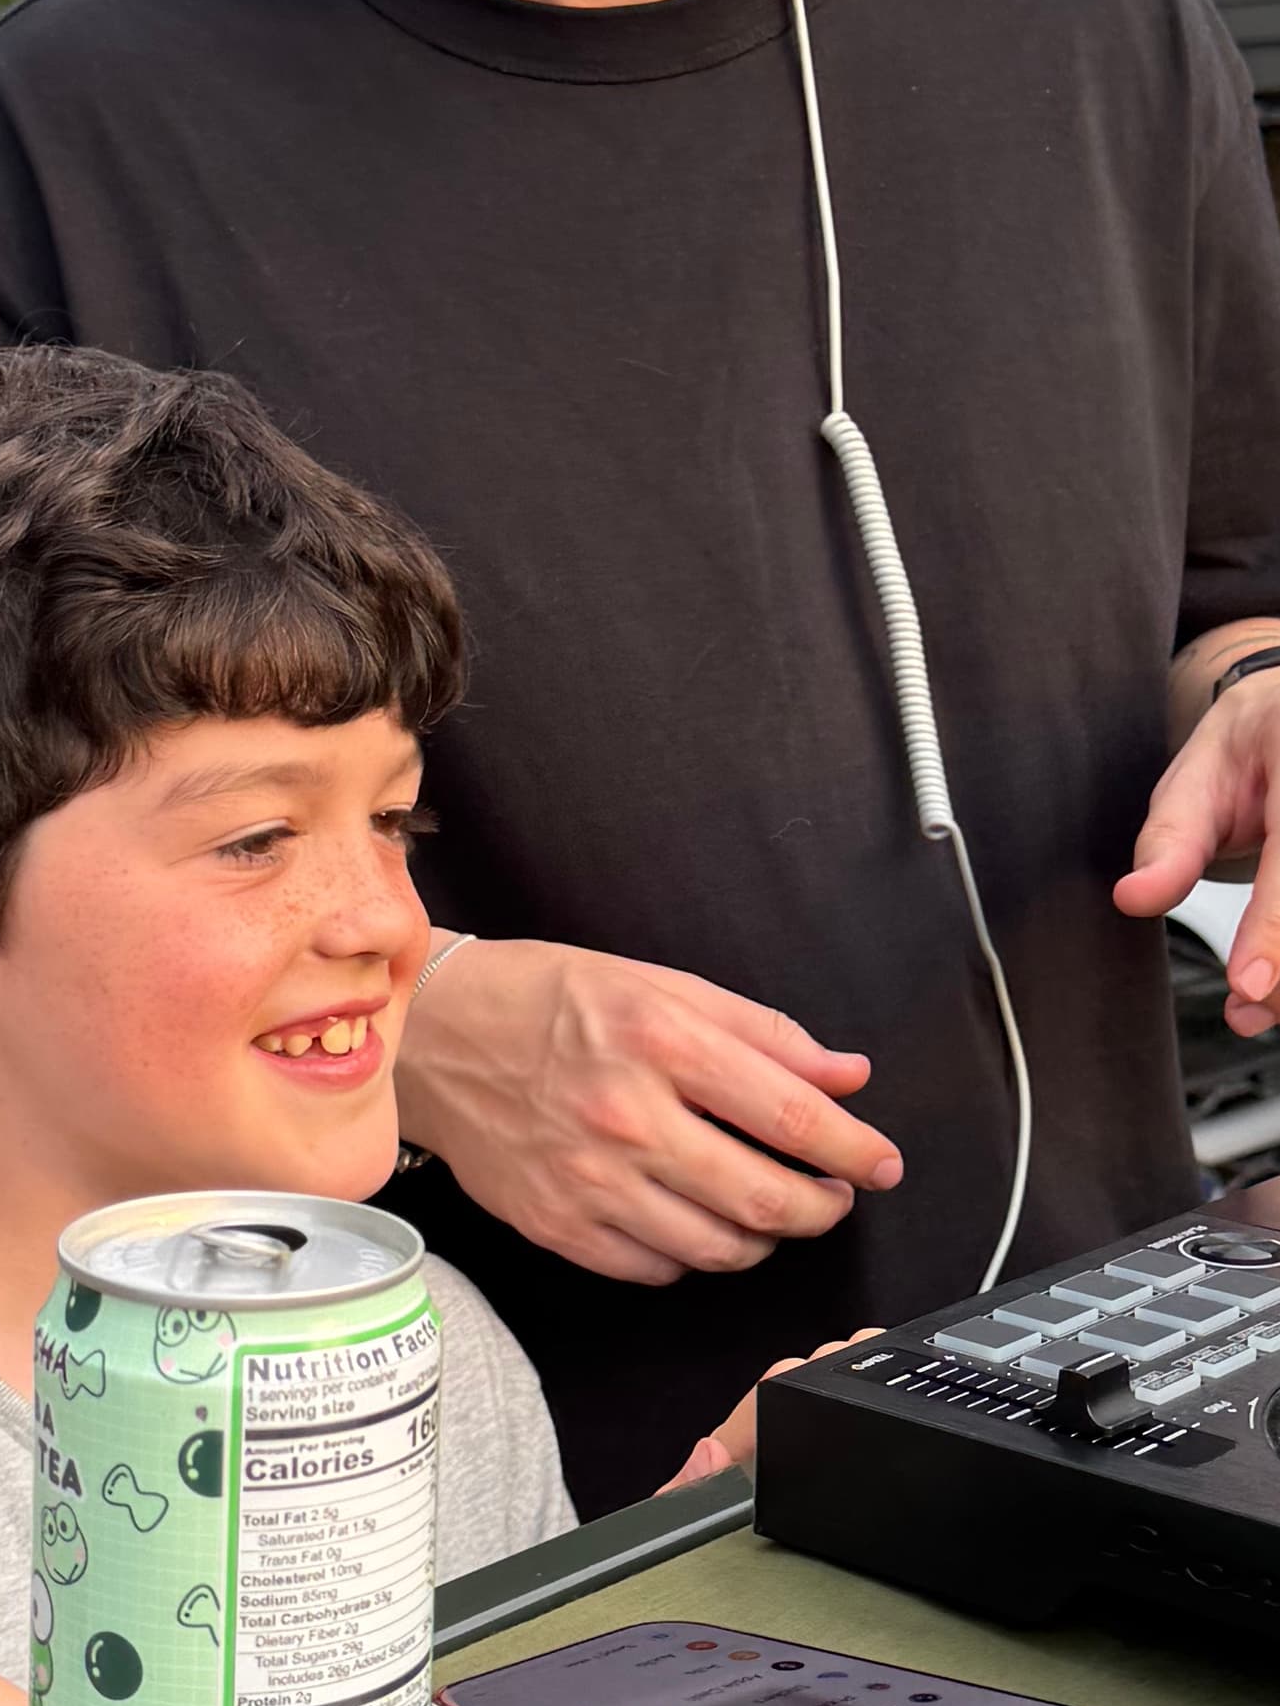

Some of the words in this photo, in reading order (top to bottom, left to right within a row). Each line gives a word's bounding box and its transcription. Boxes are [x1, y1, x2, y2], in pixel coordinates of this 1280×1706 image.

[248, 1349, 388, 1382] Nutrition
[391, 1319, 437, 1357] Facts
[260, 1383, 318, 1403] servings
[322, 1381, 342, 1399] per
[348, 1368, 398, 1391] container
[245, 1404, 317, 1422] Serving
[322, 1399, 355, 1416] size
[245, 1442, 294, 1456] Amount
[299, 1440, 319, 1453] Per
[323, 1435, 365, 1450] Serving
[245, 1448, 375, 1482] Calories
[243, 1513, 279, 1527] Total
[284, 1511, 307, 1525] Fat
[257, 1529, 325, 1547] Saturated
[329, 1524, 349, 1538] Fat
[258, 1552, 297, 1567] Trans
[301, 1549, 323, 1564] Fat
[326, 1547, 343, 1562] 0g
[240, 1569, 325, 1588] Cholesterol
[330, 1562, 363, 1579] 10mg
[240, 1592, 297, 1609] Sodium
[240, 1614, 276, 1629] Total
[280, 1597, 371, 1626] Carbohydrate
[255, 1632, 305, 1649] Dietary
[309, 1626, 341, 1642] Fiber
[255, 1652, 288, 1668] Total
[292, 1647, 338, 1666] Sugars
[267, 1668, 324, 1686] Includes
[352, 1649, 387, 1672] Added
[295, 1691, 312, 1706] 2g
